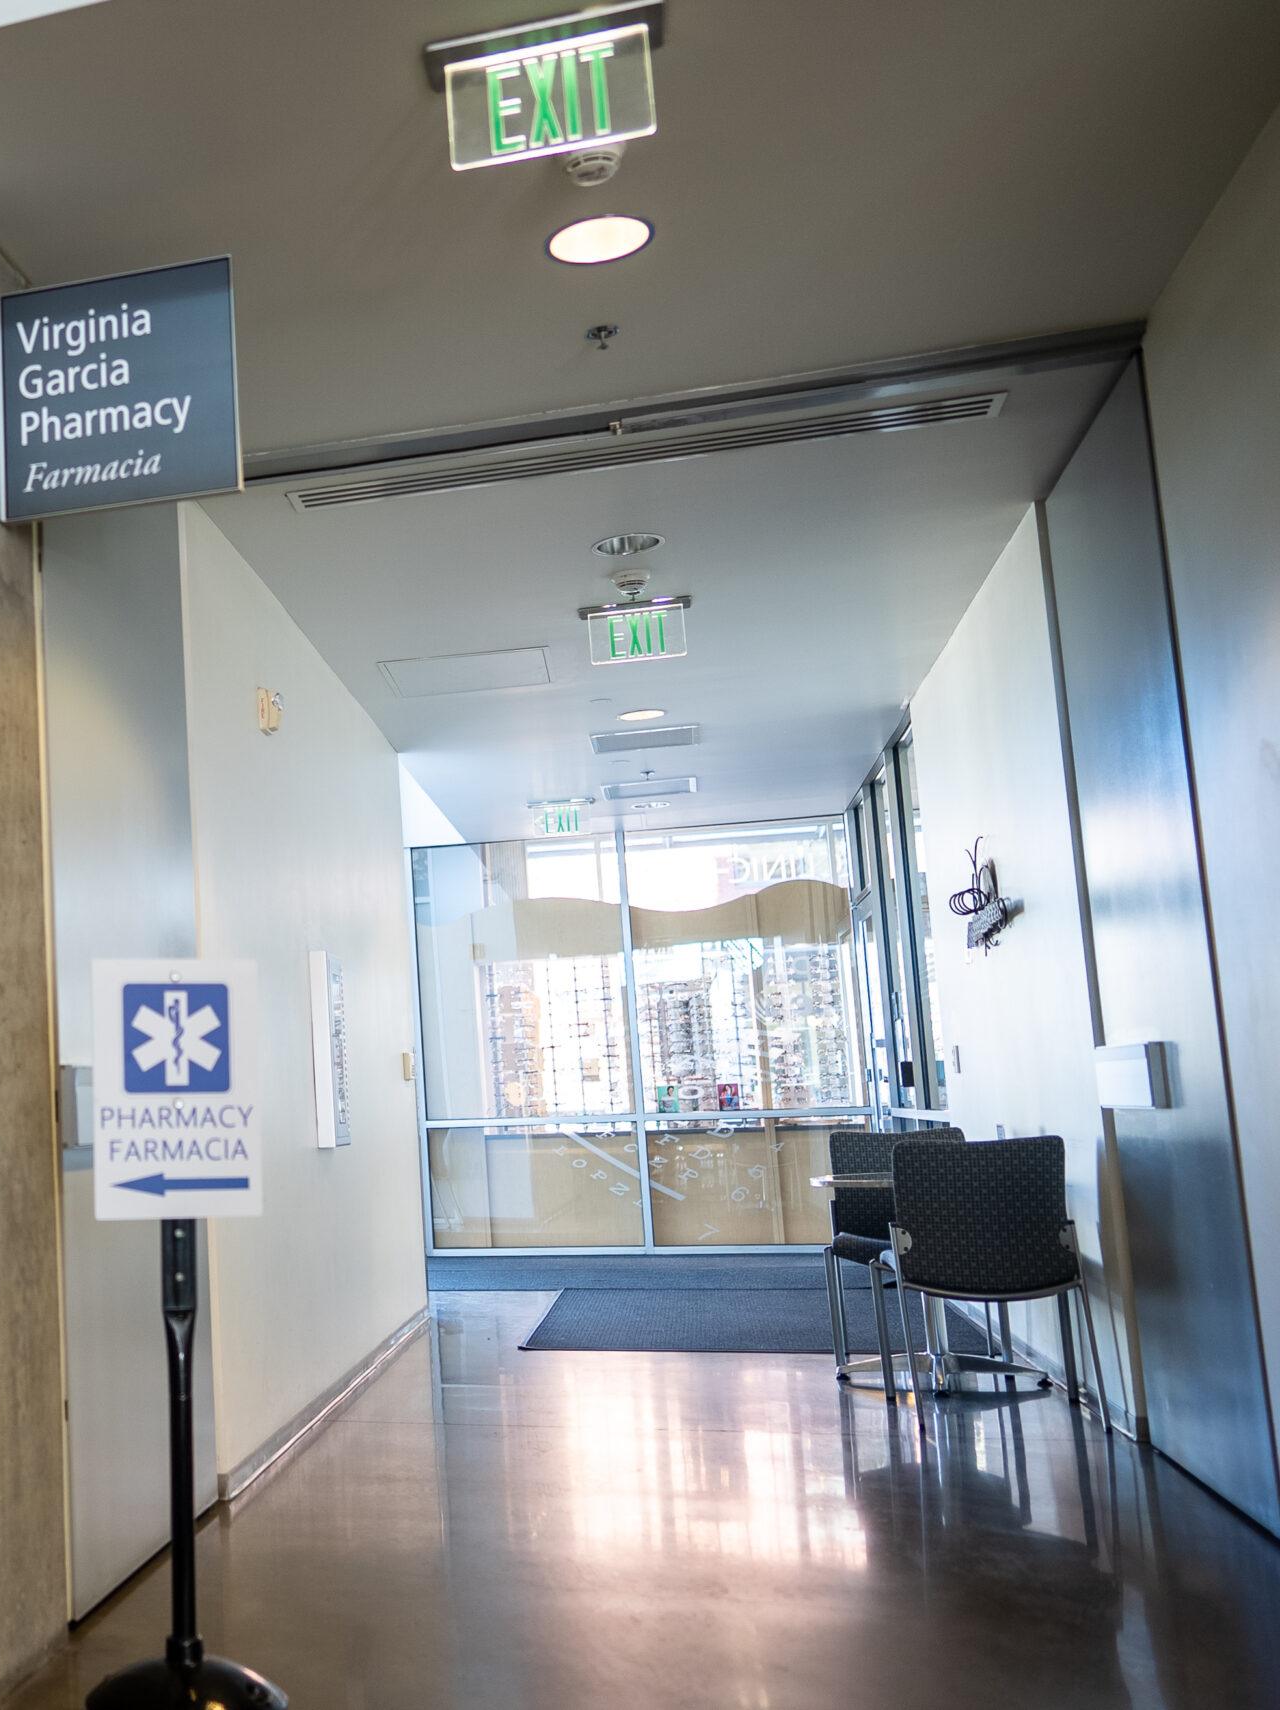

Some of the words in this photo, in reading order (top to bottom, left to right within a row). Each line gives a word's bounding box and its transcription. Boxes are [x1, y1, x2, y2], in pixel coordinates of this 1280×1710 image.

[485, 41, 615, 157] EXIT
[16, 302, 153, 357] Virginia
[18, 352, 131, 400] Garcia
[20, 395, 192, 447] Pharmacy
[23, 449, 162, 493] Farmacia
[607, 609, 668, 660] EXIT
[543, 804, 581, 835] EXIT
[99, 1103, 254, 1130] PHARMACY
[108, 1136, 250, 1163] FARMACIA
